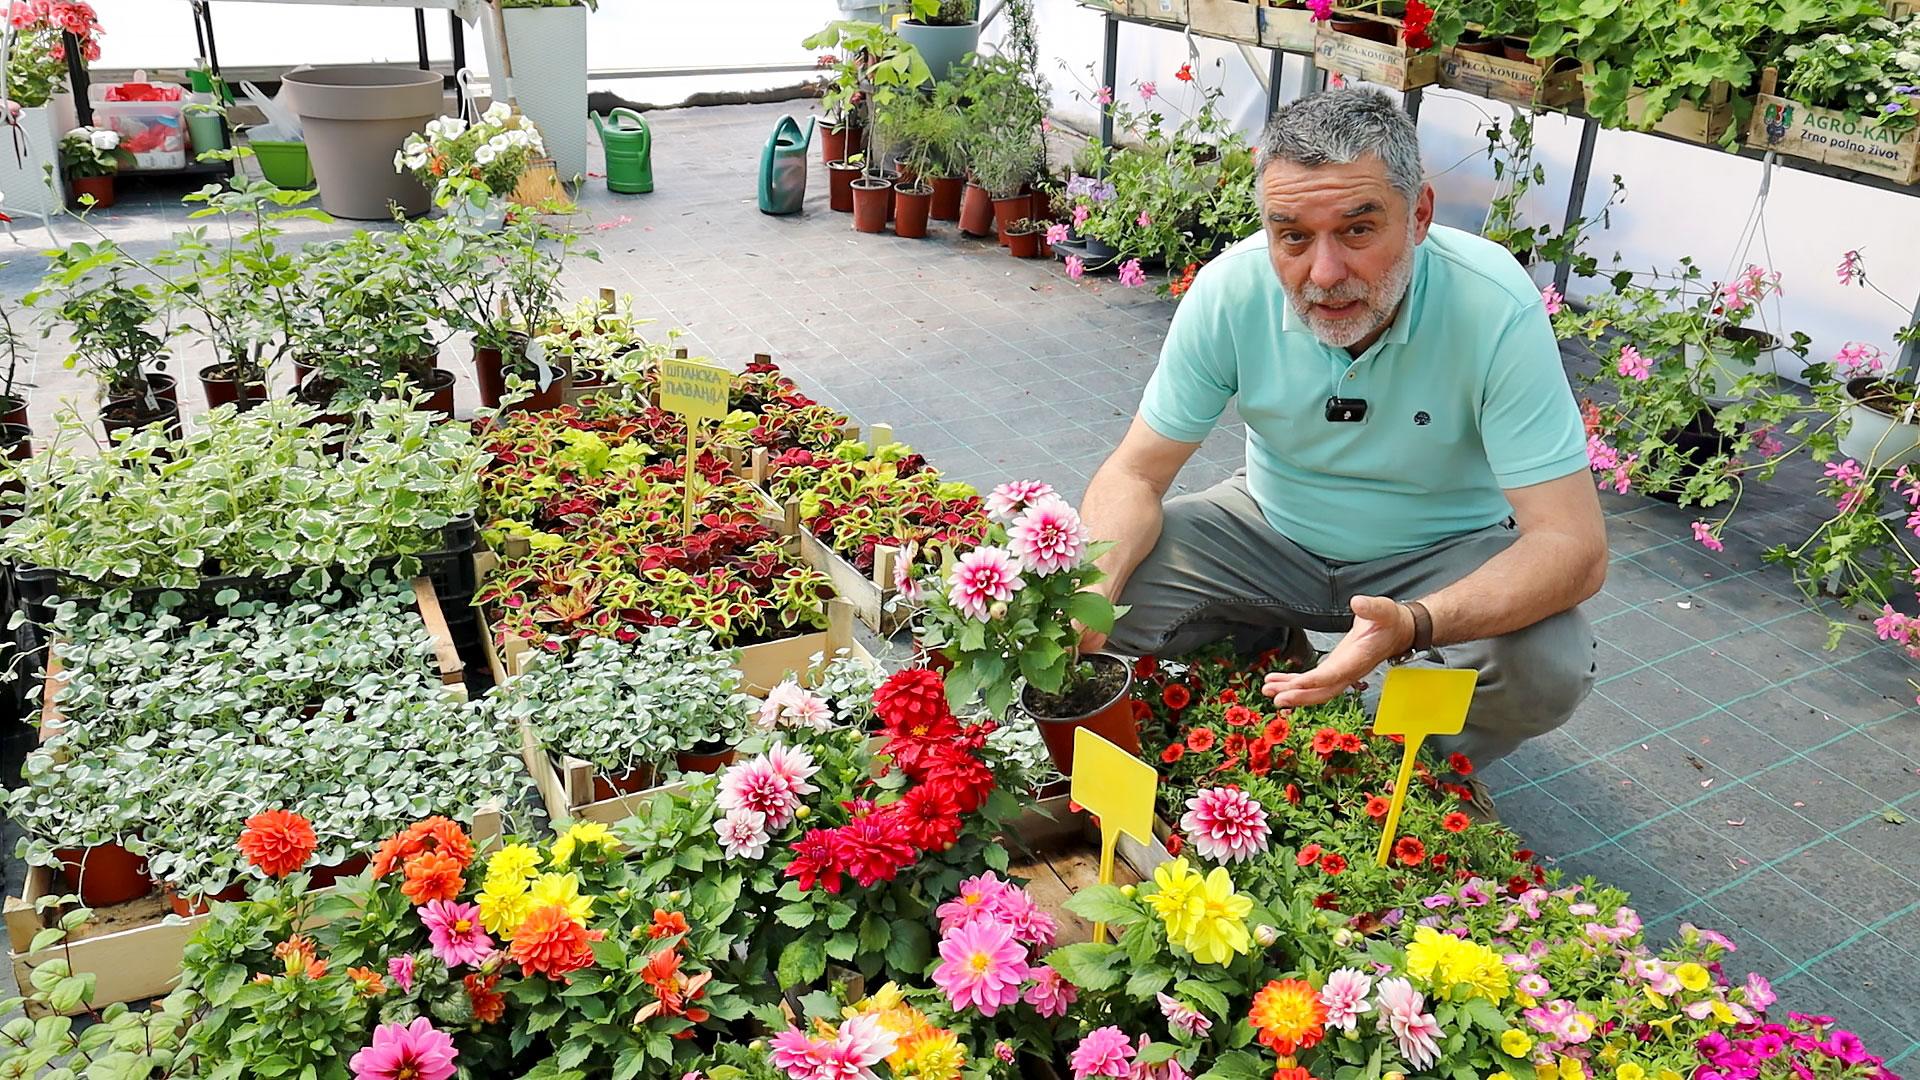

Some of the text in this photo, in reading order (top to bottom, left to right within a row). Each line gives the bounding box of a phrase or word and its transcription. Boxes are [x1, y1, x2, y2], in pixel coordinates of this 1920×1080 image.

[1803, 112, 1904, 144] AGRO-KAV
[1800, 129, 1900, 160] Zrno polno život
